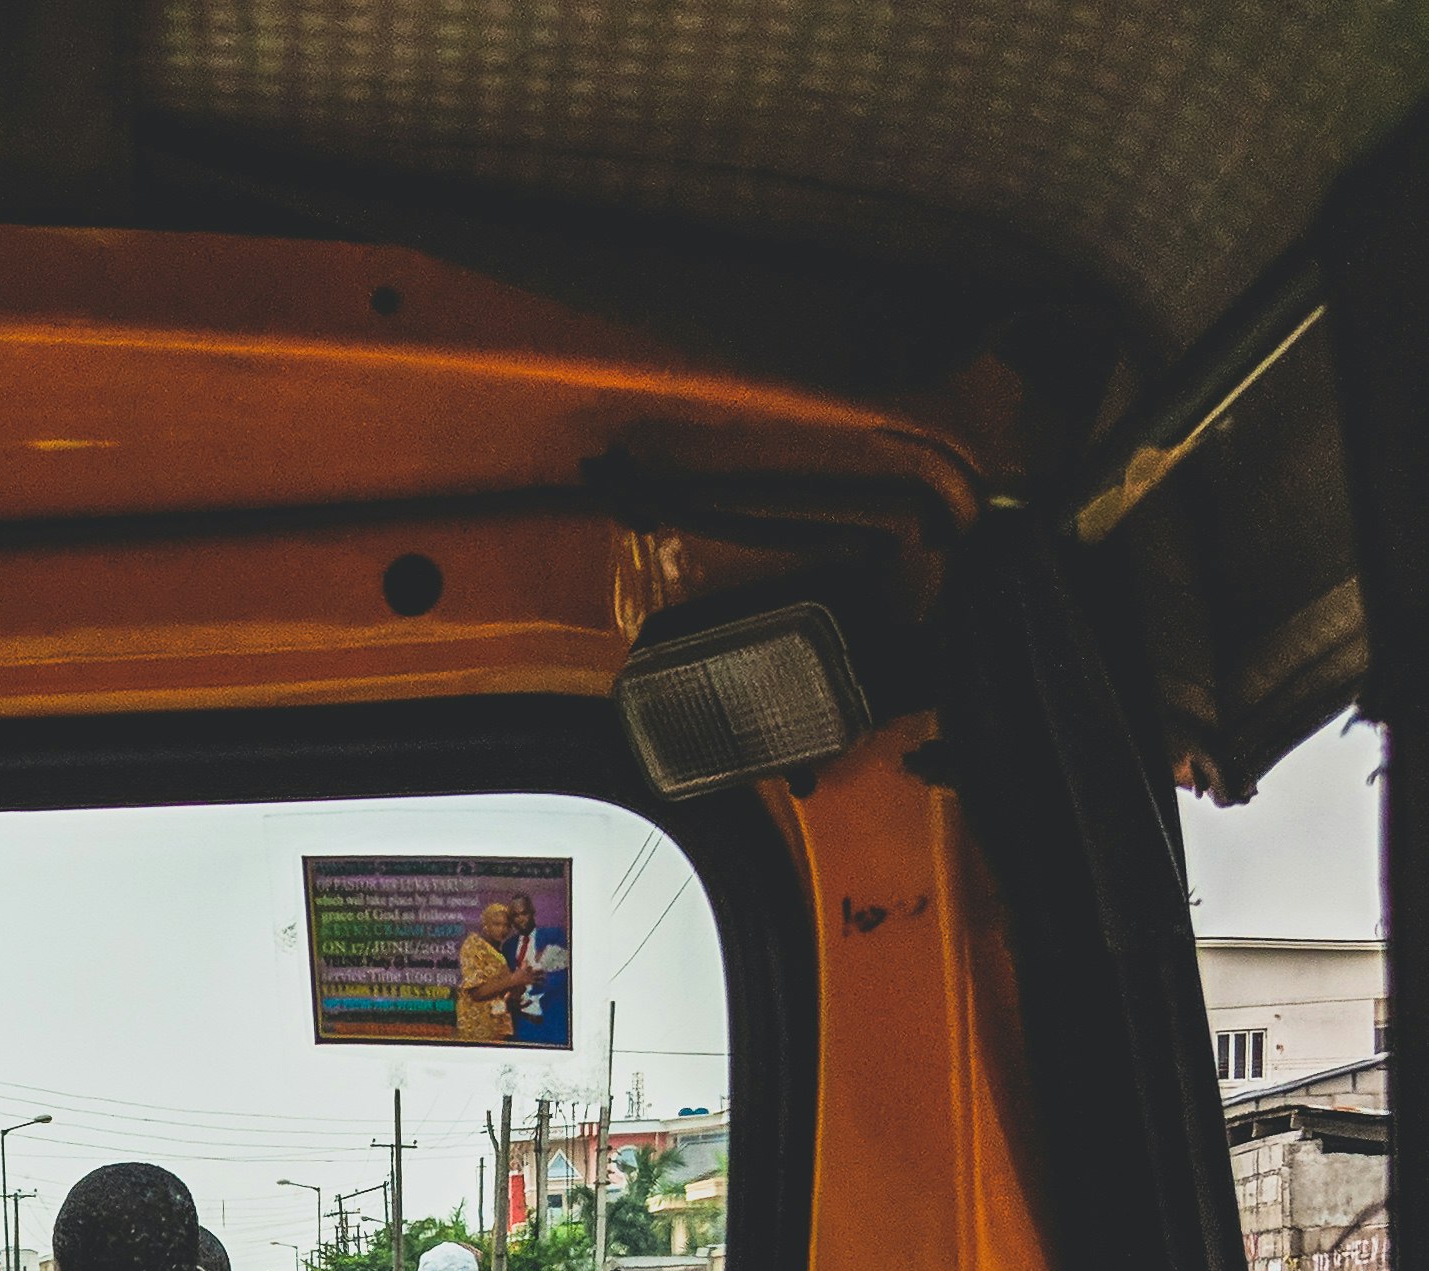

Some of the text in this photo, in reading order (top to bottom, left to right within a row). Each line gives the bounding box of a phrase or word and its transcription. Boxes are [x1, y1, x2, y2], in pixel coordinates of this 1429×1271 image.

[315, 896, 343, 906] which
[346, 895, 364, 906] will
[321, 911, 353, 924] grace
[356, 909, 370, 921] of
[372, 909, 400, 921] God
[322, 941, 346, 955] ON
